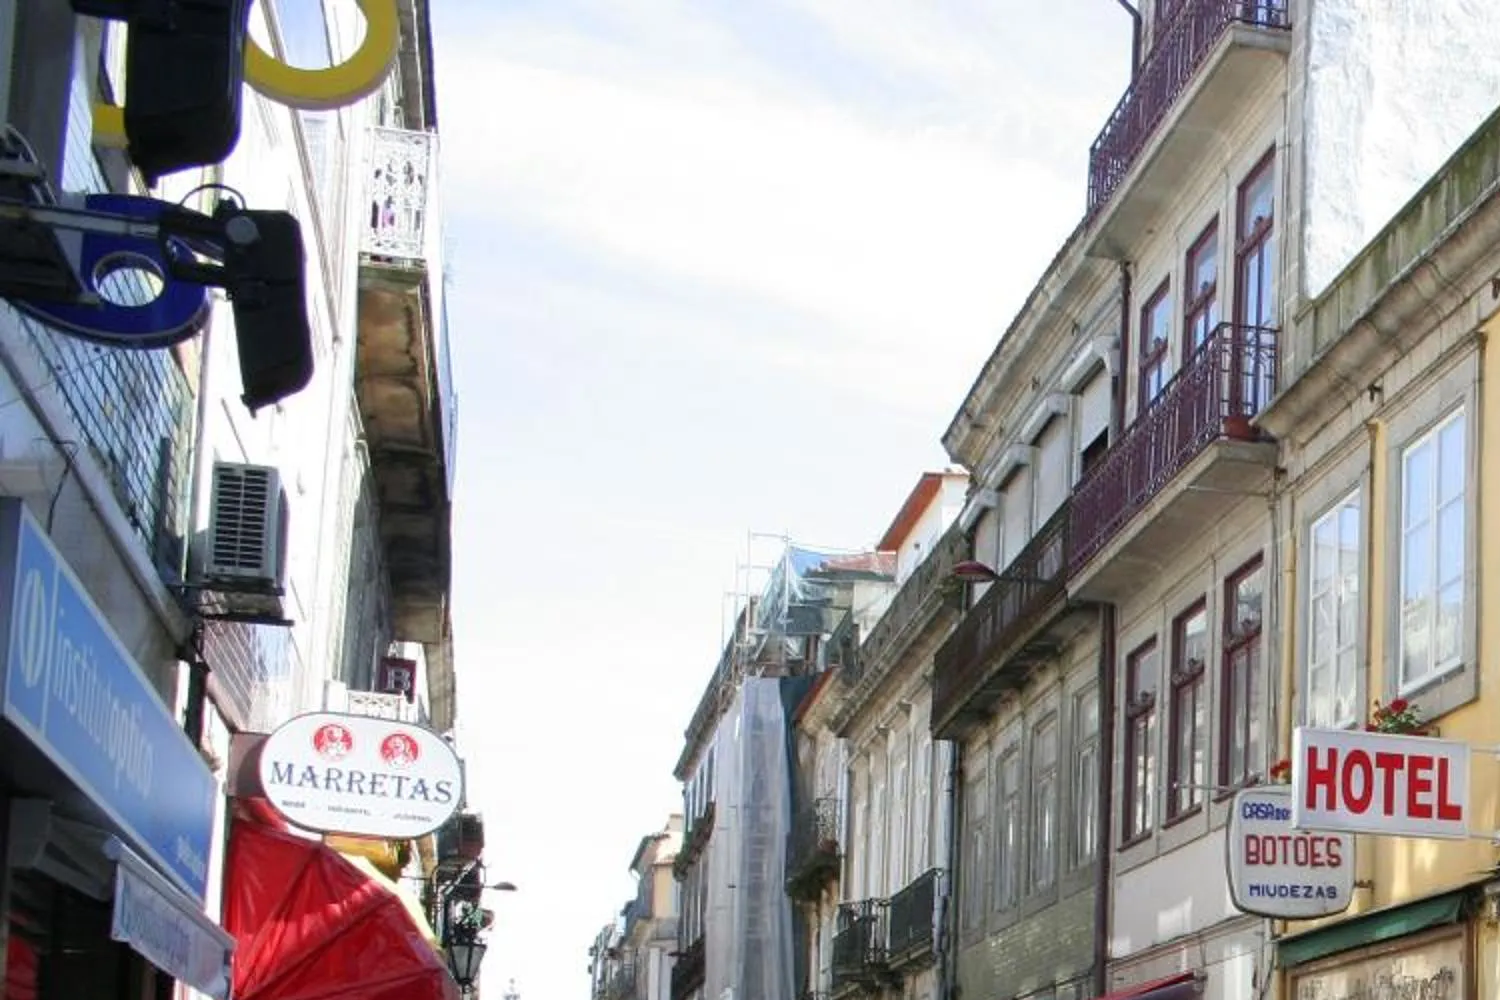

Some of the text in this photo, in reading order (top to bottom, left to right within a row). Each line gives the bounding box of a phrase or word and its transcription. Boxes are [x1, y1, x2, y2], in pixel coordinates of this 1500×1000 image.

[269, 760, 453, 805] MARRETAS
[1306, 746, 1462, 821] HOTEL
[1243, 802, 1274, 820] CASA
[1249, 884, 1337, 899] MIUDEZAS
